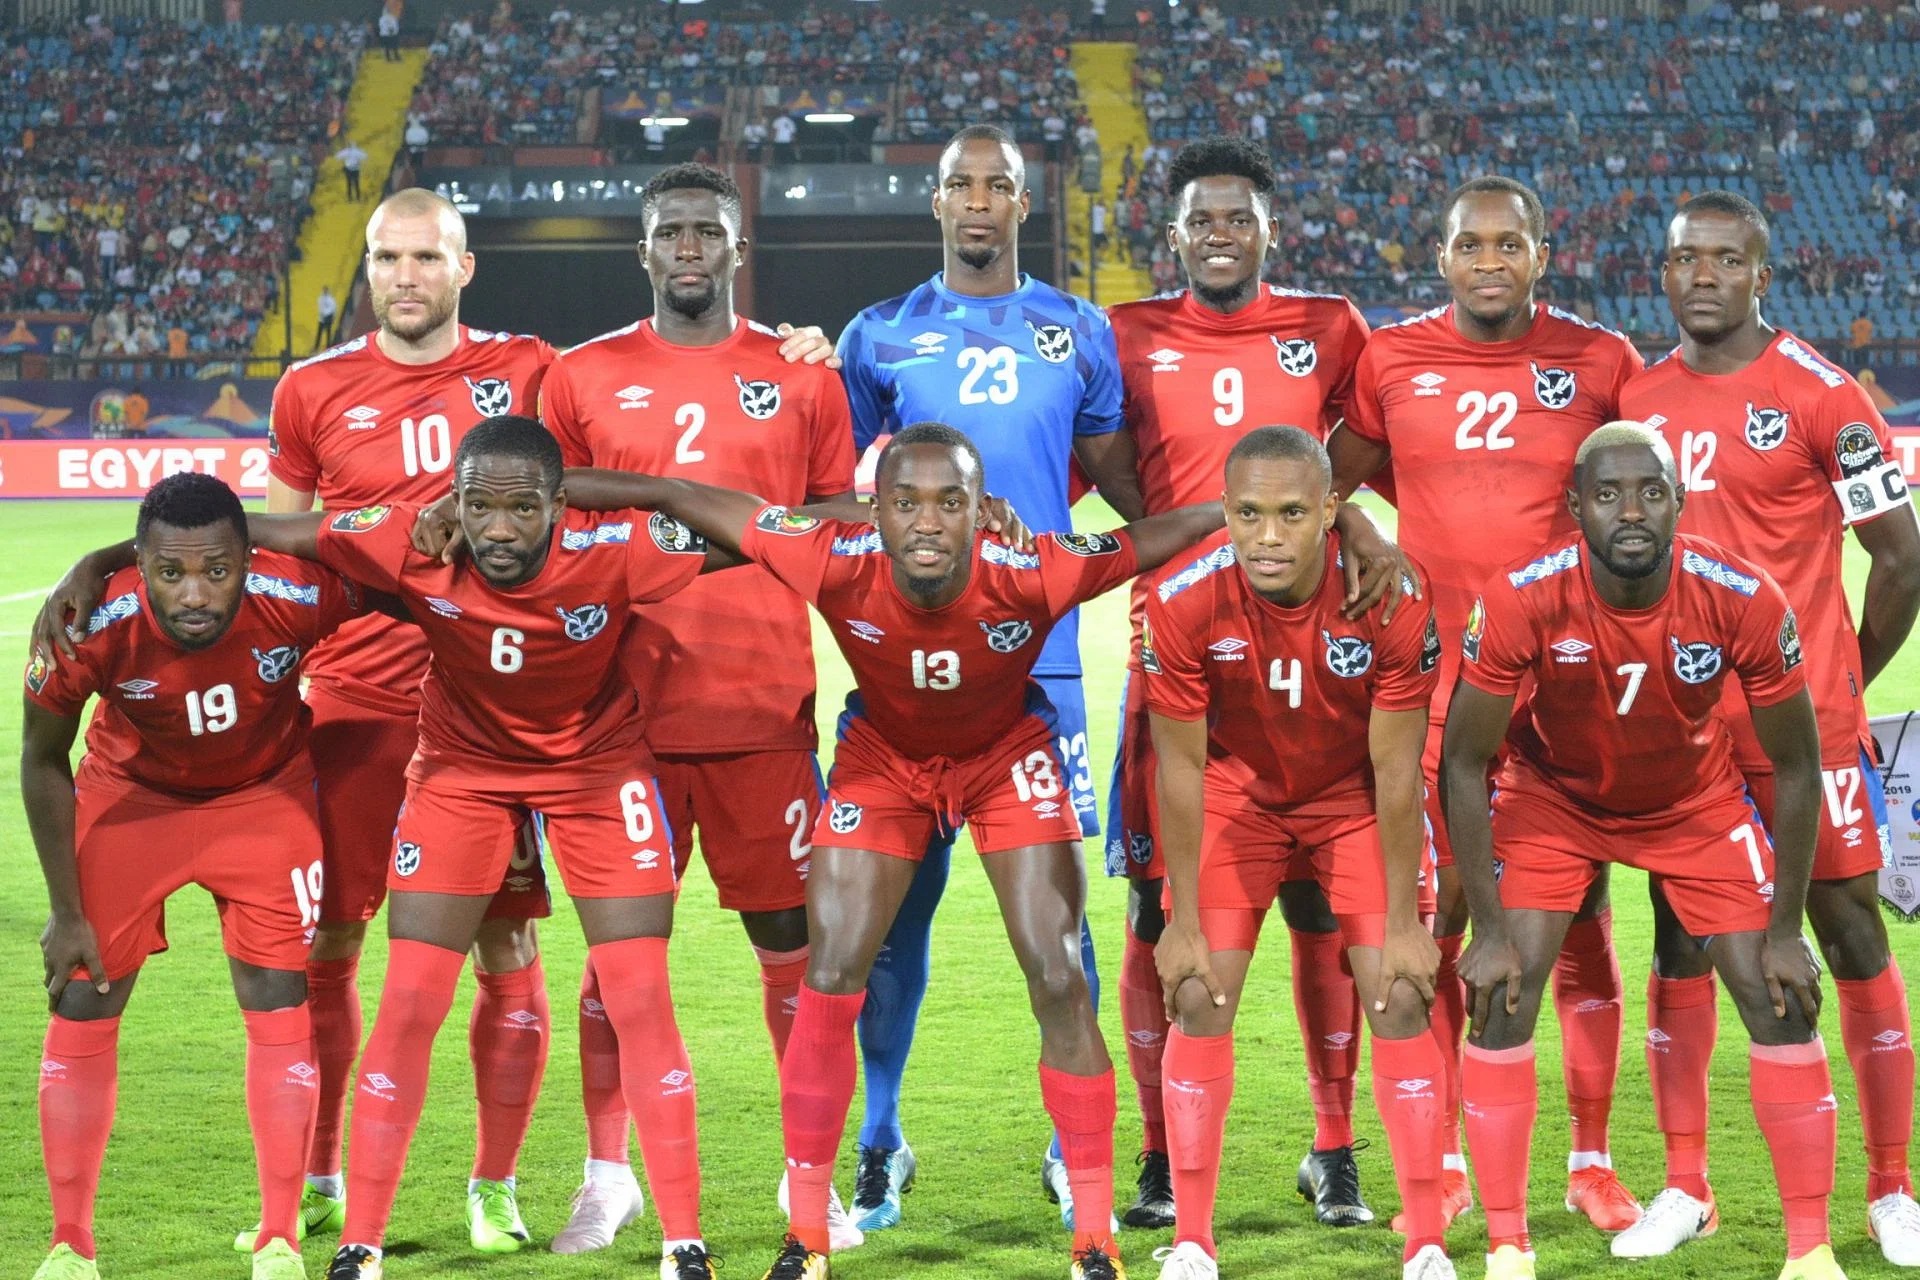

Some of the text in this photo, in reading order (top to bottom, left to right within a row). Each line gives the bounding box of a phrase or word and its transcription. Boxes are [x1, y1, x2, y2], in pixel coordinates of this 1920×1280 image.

[957, 346, 1019, 405] 23
[1212, 367, 1244, 426] 9
[401, 414, 452, 477] 10
[674, 402, 706, 465] 2
[1455, 390, 1518, 450] 22
[58, 448, 226, 489] EGYPT
[1680, 431, 1717, 492] 12
[1881, 467, 1908, 502] C
[490, 627, 525, 674] 6
[911, 649, 961, 691] 13
[1213, 652, 1245, 661] umbro
[1556, 654, 1588, 664] umbro
[185, 683, 238, 736] 19
[1269, 658, 1302, 708] 4
[1616, 662, 1648, 716] 7
[1011, 750, 1060, 802] 13
[1822, 767, 1863, 828] 12
[1885, 785, 1911, 795] 2019
[619, 780, 654, 843] 6
[784, 799, 812, 861] 2
[1728, 823, 1766, 884] 7
